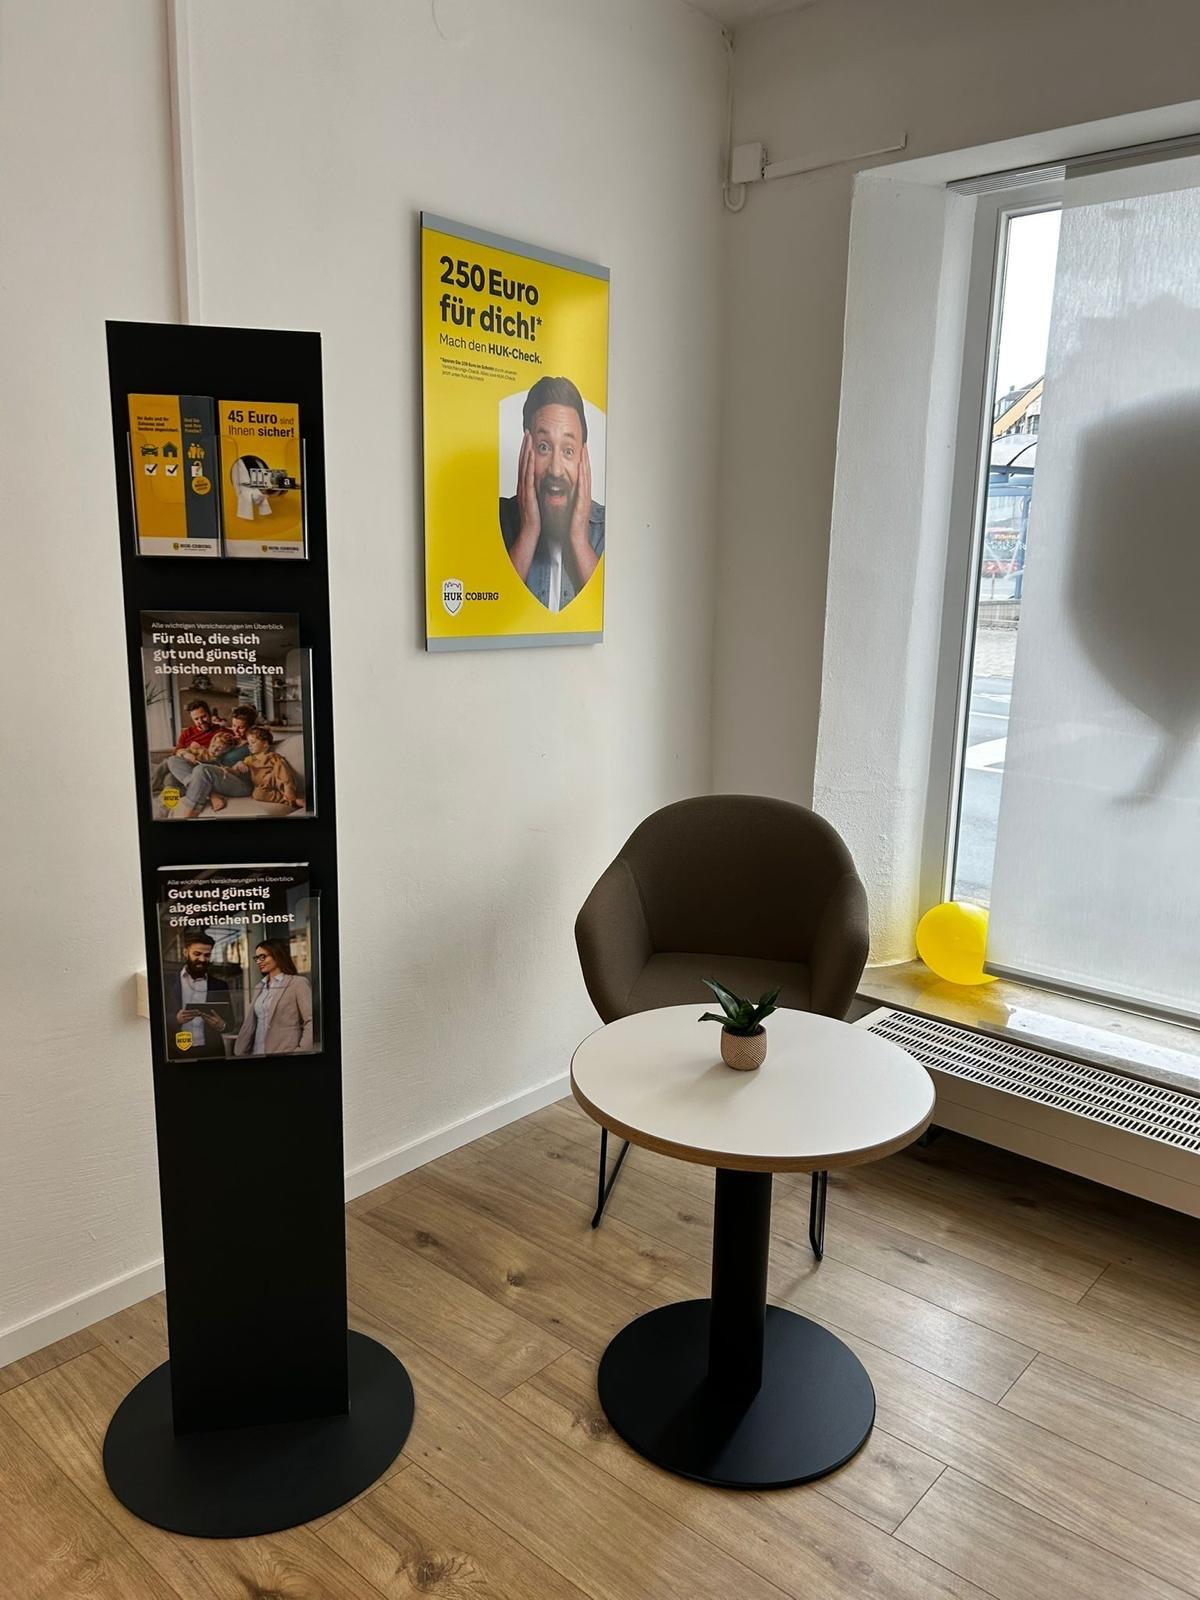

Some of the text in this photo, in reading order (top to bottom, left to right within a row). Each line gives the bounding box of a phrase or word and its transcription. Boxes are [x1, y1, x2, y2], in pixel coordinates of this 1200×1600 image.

[440, 256, 539, 305] 250 Euro
[440, 293, 475, 327] für
[440, 333, 542, 364] Mach den HUK-Check.
[228, 410, 294, 425] 45 Euro sind
[228, 426, 294, 437] Ihnen sicher!
[444, 592, 499, 600] HUK COBURG
[152, 632, 260, 646] Für alle, die sich
[153, 648, 256, 662] gut und günstig
[154, 664, 284, 675] absichern möchten
[168, 886, 270, 900] Gut und günstig
[169, 900, 264, 915] abgesichert im
[170, 913, 295, 927] öffentlichen Dienst
